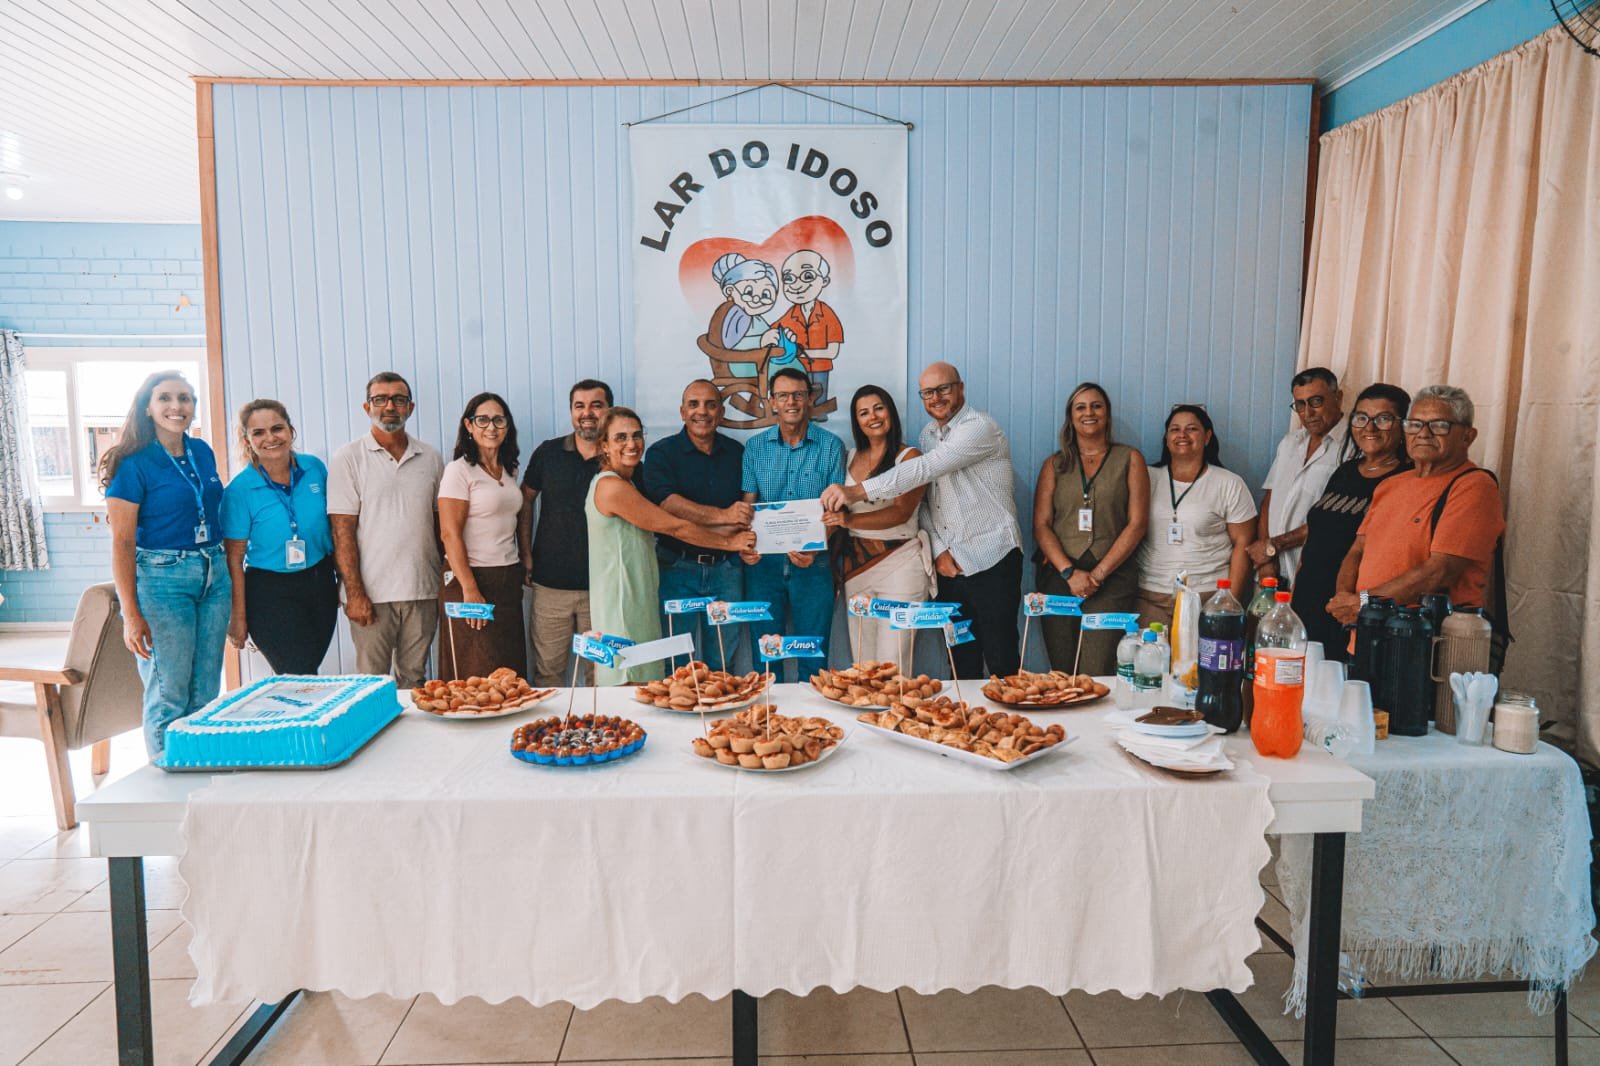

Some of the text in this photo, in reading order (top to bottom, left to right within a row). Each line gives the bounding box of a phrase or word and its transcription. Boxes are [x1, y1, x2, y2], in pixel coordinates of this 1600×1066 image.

[640, 140, 893, 252] LAR DO IDOSO
[786, 639, 816, 651] Amor
